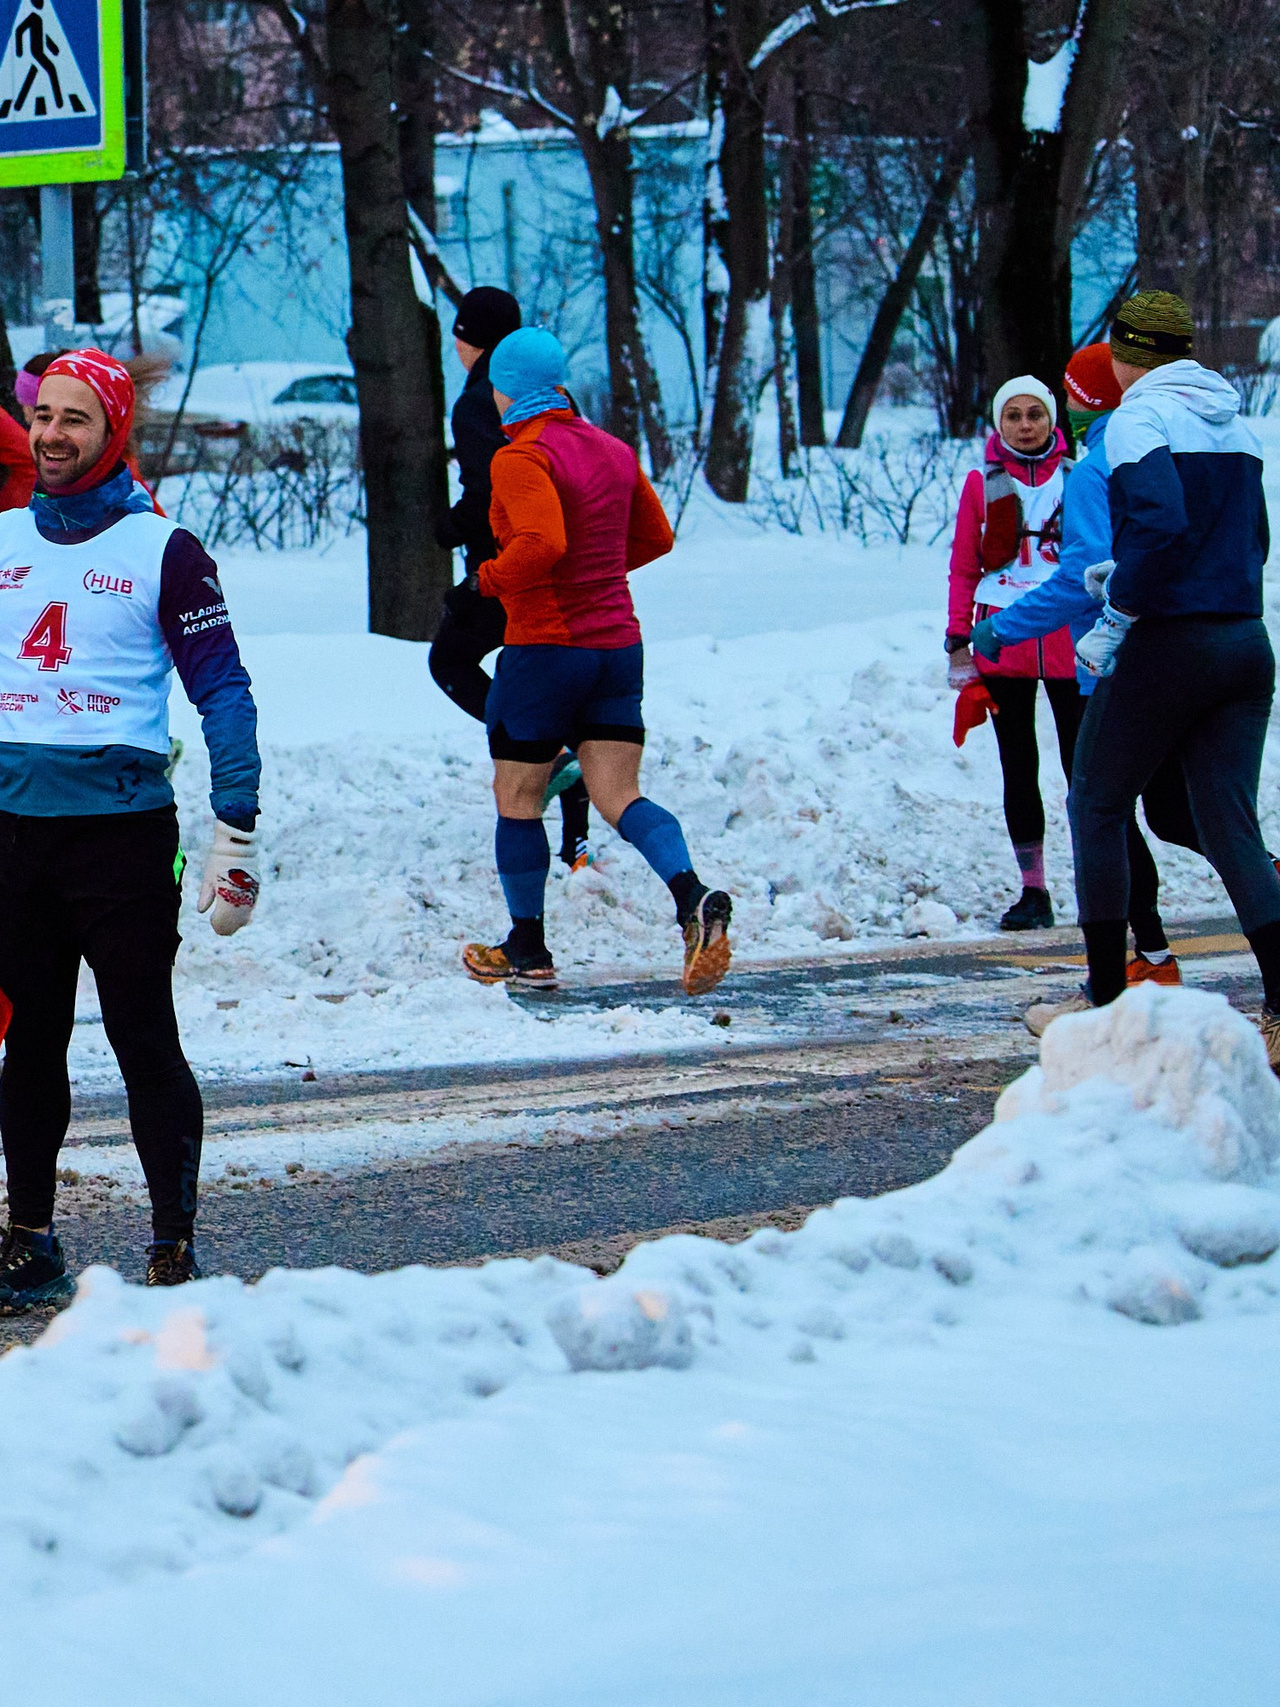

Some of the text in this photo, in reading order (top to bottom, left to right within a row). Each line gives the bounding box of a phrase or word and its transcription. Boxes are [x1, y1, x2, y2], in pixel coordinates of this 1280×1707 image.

[91, 573, 133, 594] НЦВ
[17, 601, 72, 672] 4
[87, 694, 120, 706] ППОО
[87, 704, 111, 714] НЦВ
